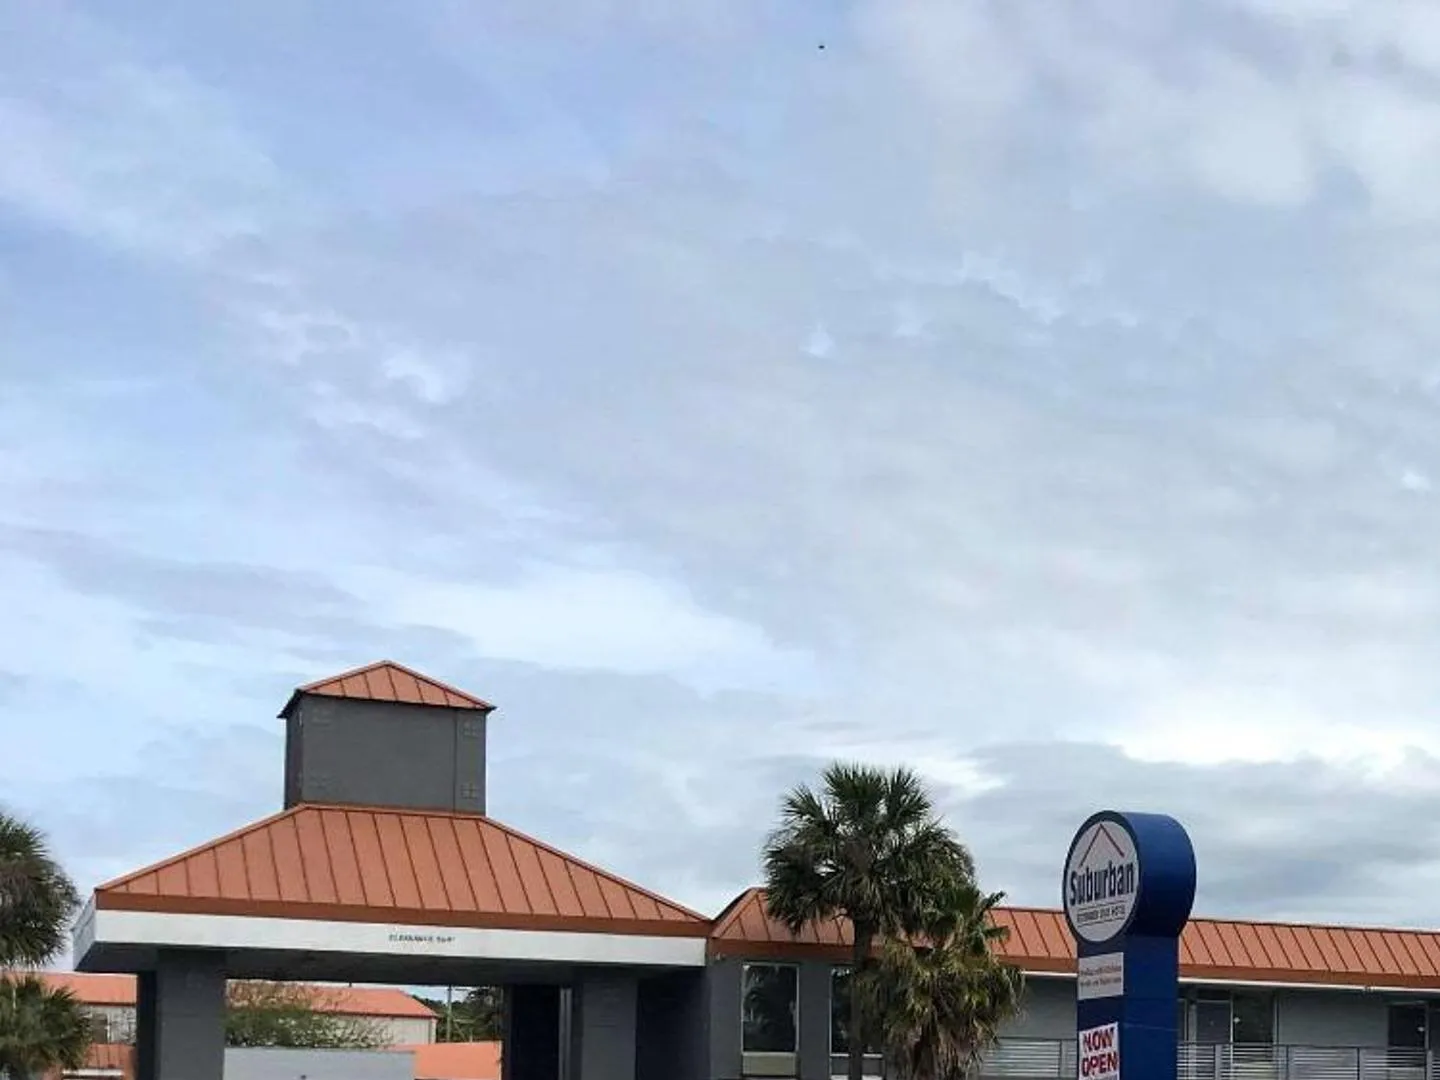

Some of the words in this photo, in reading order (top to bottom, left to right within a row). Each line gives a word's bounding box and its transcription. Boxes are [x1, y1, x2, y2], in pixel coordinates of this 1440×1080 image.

[1069, 860, 1134, 906] Suburban
[1083, 1027, 1115, 1053] NOW
[1082, 1051, 1117, 1077] OPEN
